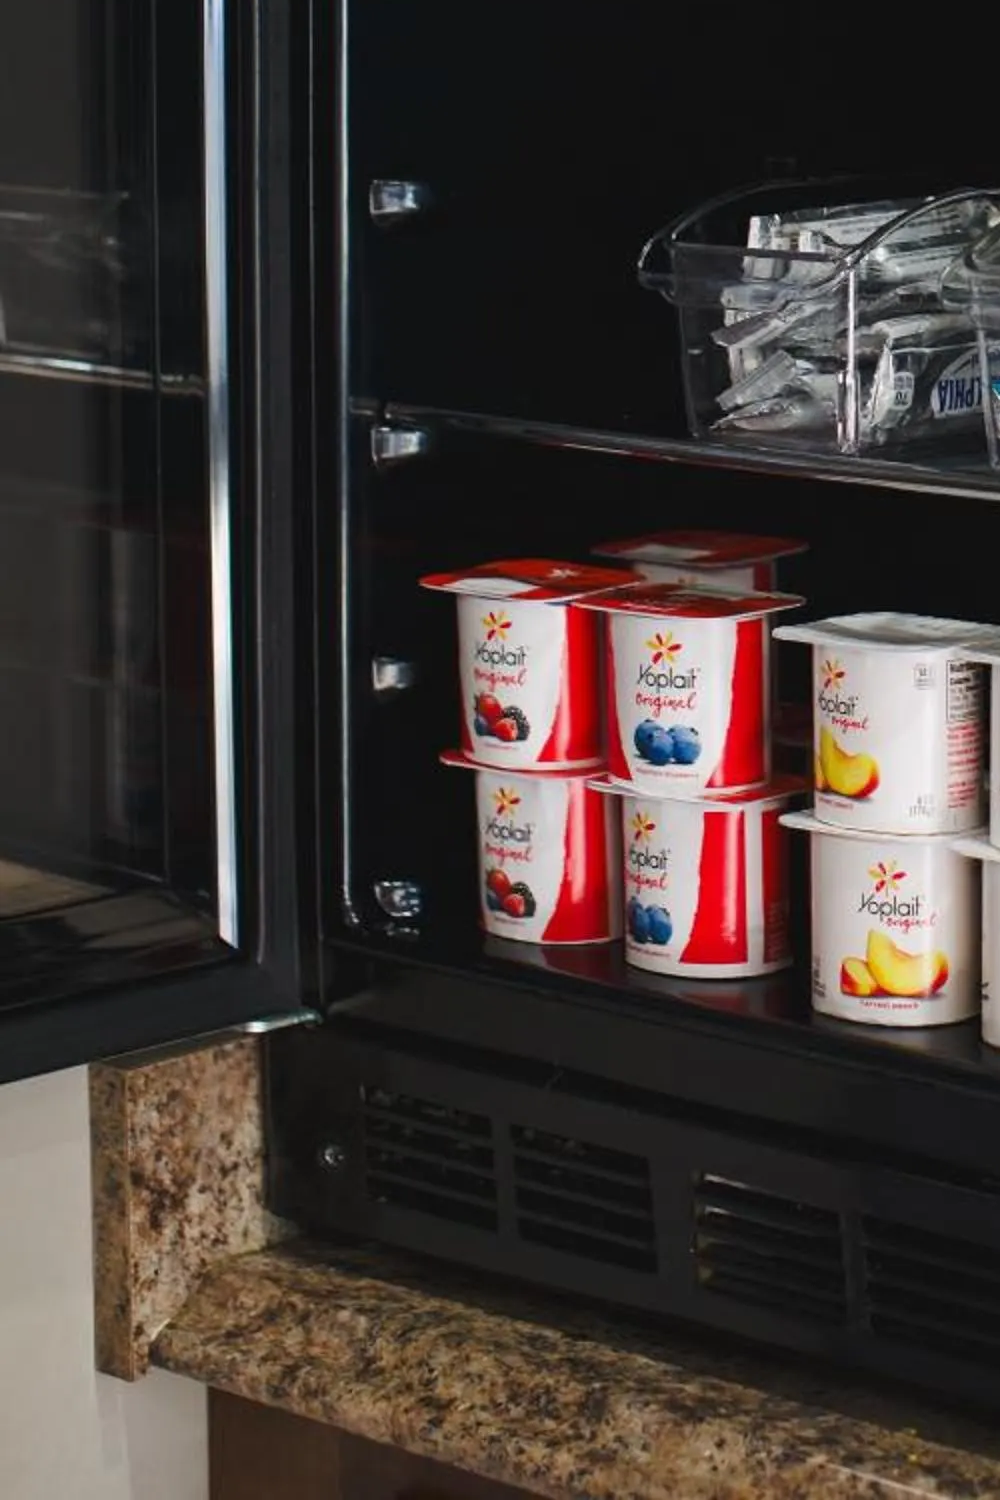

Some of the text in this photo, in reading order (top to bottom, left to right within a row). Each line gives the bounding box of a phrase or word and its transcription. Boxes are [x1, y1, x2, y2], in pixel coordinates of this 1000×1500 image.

[474, 641, 527, 668] Yoplait
[637, 664, 697, 693] Yoplait
[858, 892, 921, 921] Yoplait
